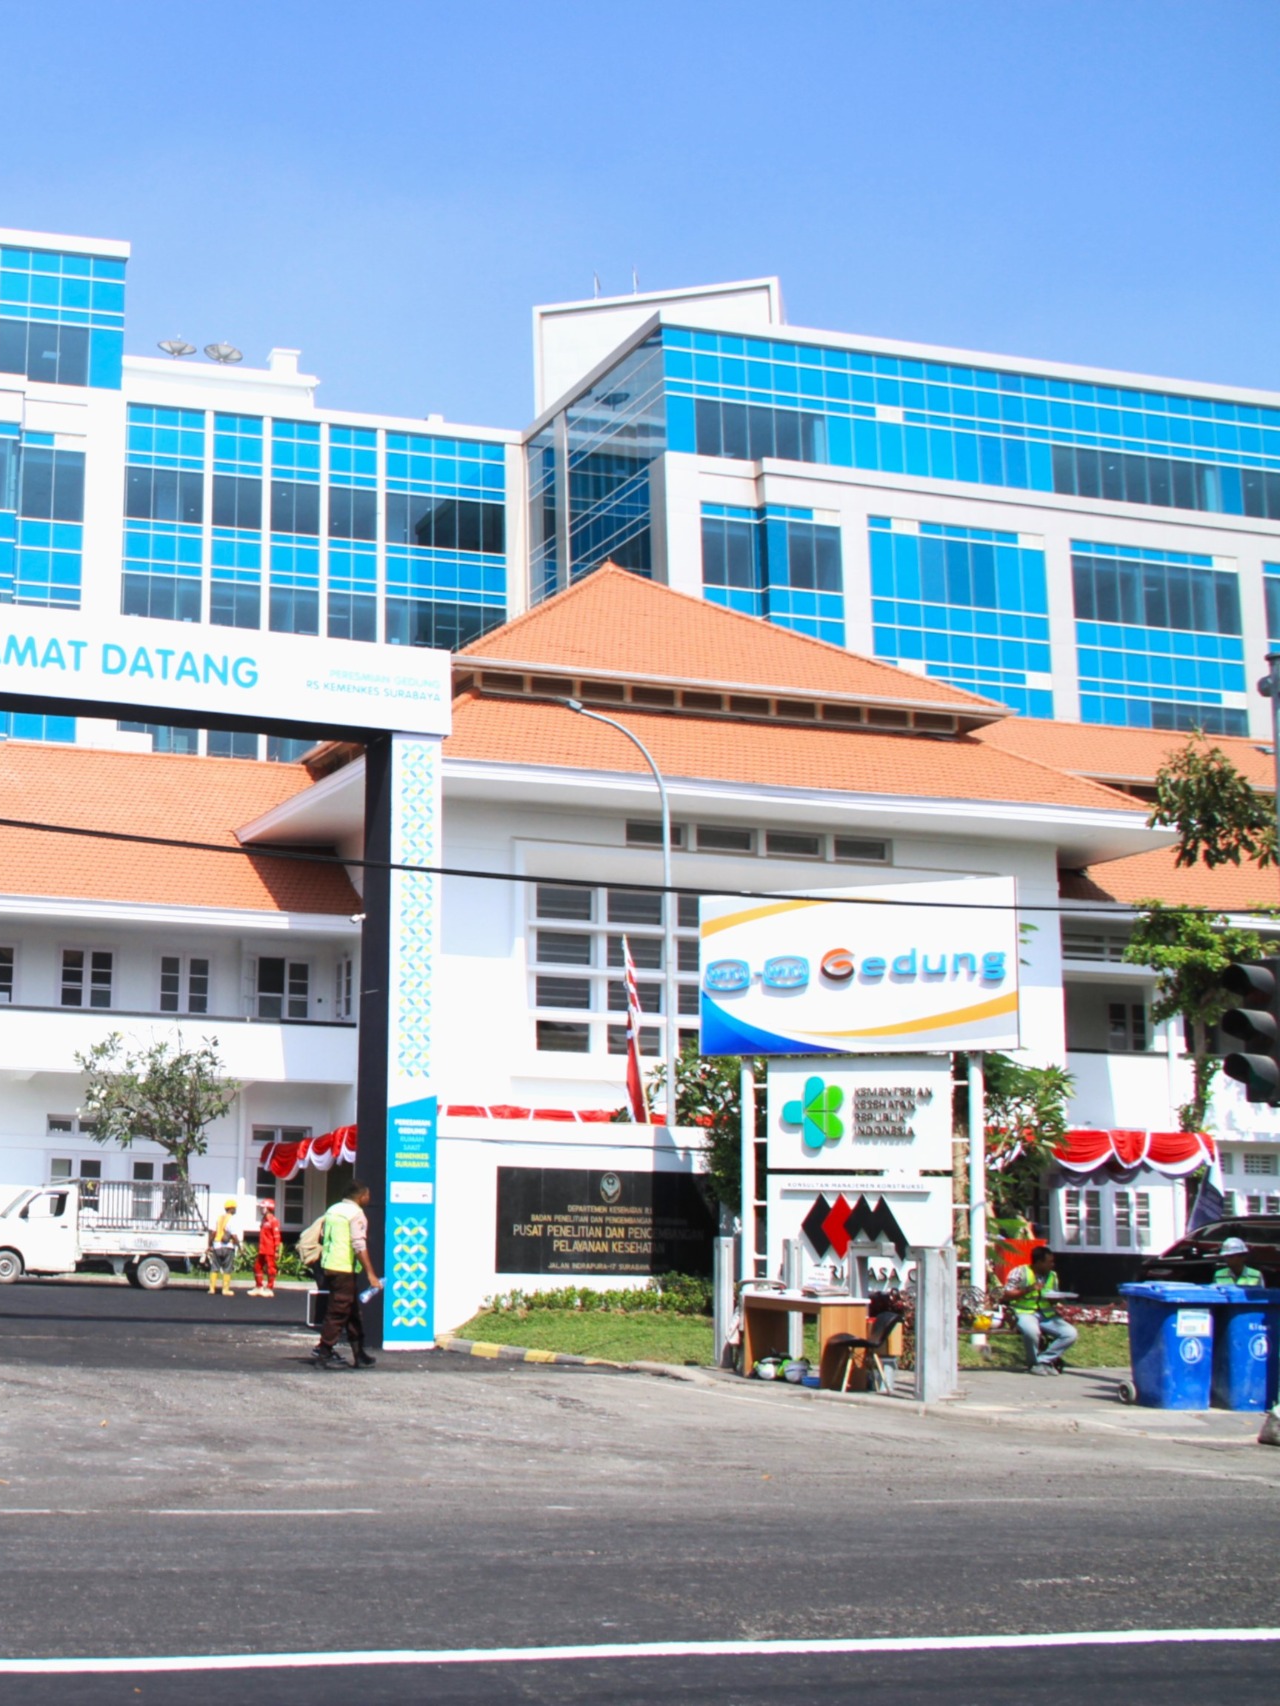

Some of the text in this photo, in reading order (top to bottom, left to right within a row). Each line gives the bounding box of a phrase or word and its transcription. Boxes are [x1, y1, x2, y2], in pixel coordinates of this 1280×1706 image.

[101, 643, 259, 689] DATANG
[328, 669, 441, 689] PERESMIAN GEDUNG
[306, 680, 441, 702] RS KEMENKES SURABAYA
[820, 947, 1007, 980] Gedung
[531, 1214, 552, 1222] BADAN
[554, 1215, 589, 1223] PENELITIAN
[590, 1216, 603, 1224] DAN
[513, 1224, 543, 1236] PUSAT
[547, 1225, 602, 1238] PENELITIAN
[605, 1226, 625, 1239] DAN
[553, 1240, 608, 1253] PELAYANAN
